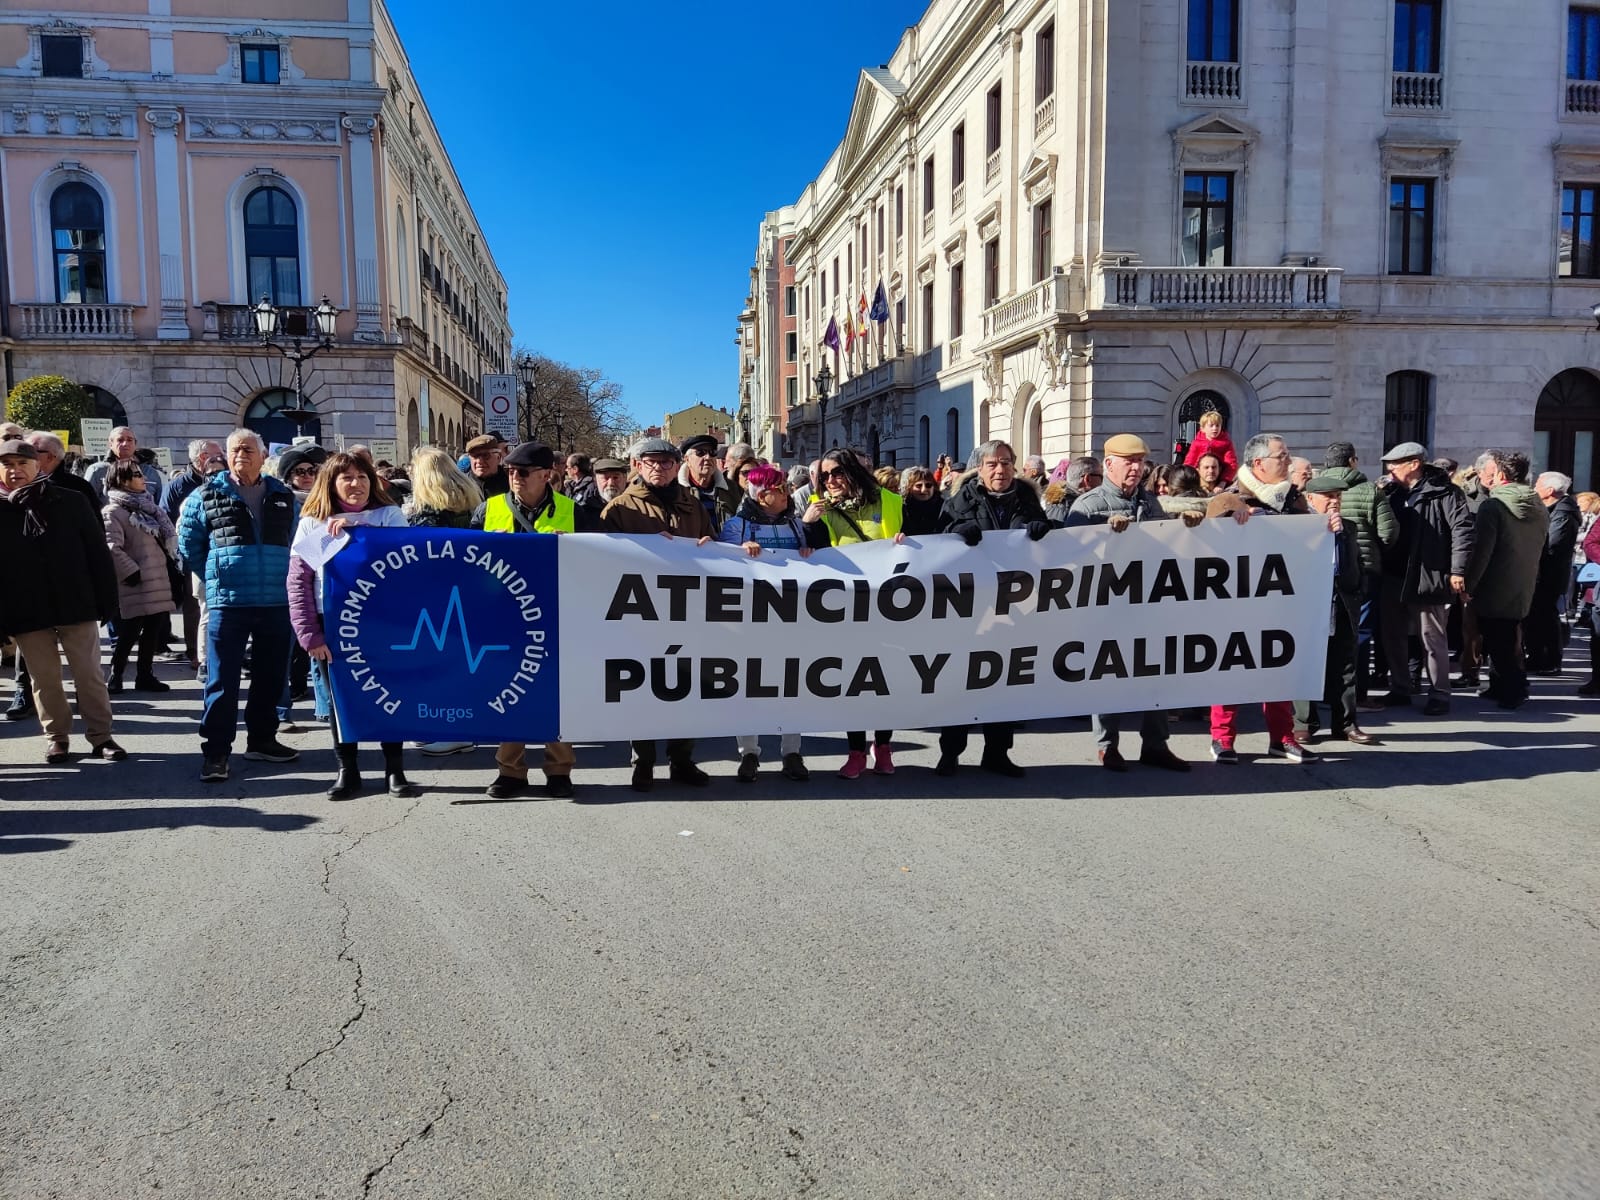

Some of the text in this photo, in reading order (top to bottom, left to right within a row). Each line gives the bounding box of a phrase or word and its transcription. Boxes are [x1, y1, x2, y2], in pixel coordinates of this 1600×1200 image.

[605, 553, 1295, 623] ATENCIÓN PRIMARIA
[339, 540, 548, 714] PLATAFORMA POR LA SANIDAD PÚBLICA
[605, 629, 1296, 703] PÚBLICA Y DE CALIDAD
[417, 703, 473, 722] Burgos
